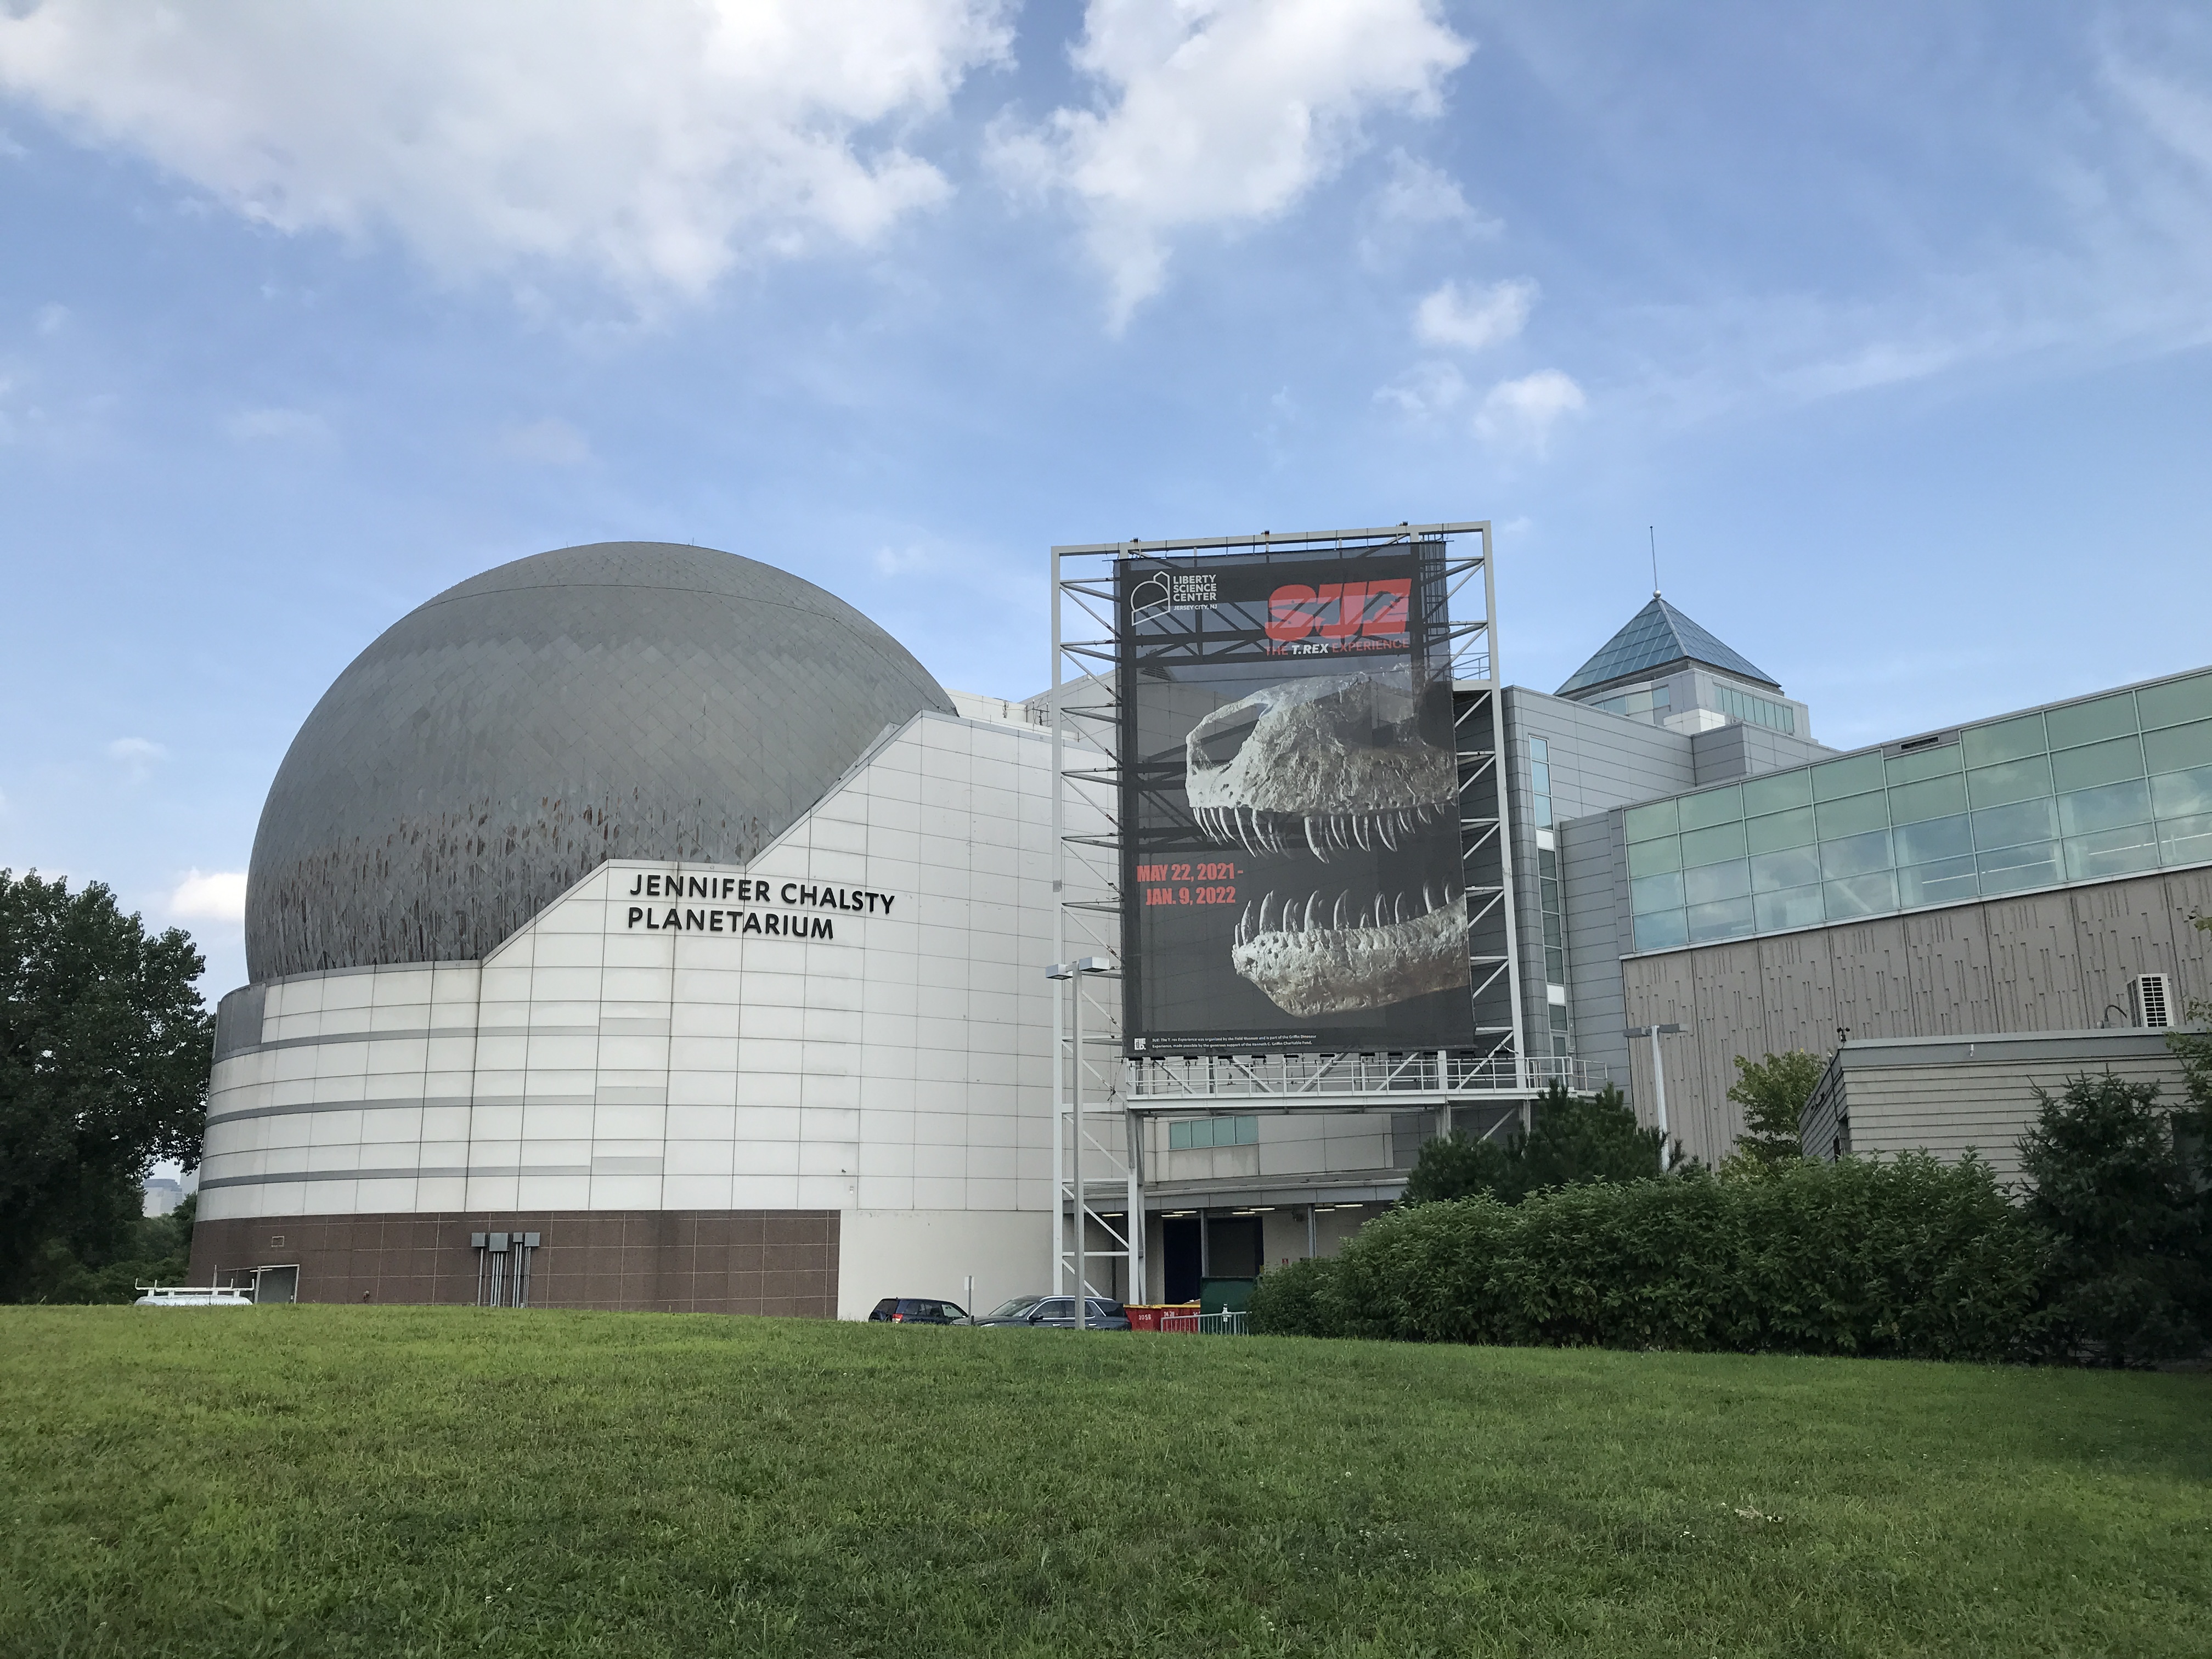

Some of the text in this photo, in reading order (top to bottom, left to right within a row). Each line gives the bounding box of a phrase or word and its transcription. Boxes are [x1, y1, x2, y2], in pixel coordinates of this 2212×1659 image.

[1173, 574, 1216, 584] LIBERTY
[1173, 583, 1217, 593] SCIENCE
[1173, 592, 1217, 602] CENTER
[1267, 637, 1410, 656] THE T.REX EXPERIENCE
[1137, 864, 1169, 882] MAY
[1171, 864, 1194, 882] 22,
[1197, 862, 1234, 881] 2021
[630, 874, 895, 915] JENNIFER CHALSTY
[1146, 885, 1236, 905] JAN. 9, 2022
[628, 907, 833, 939] PLANETARIUM
